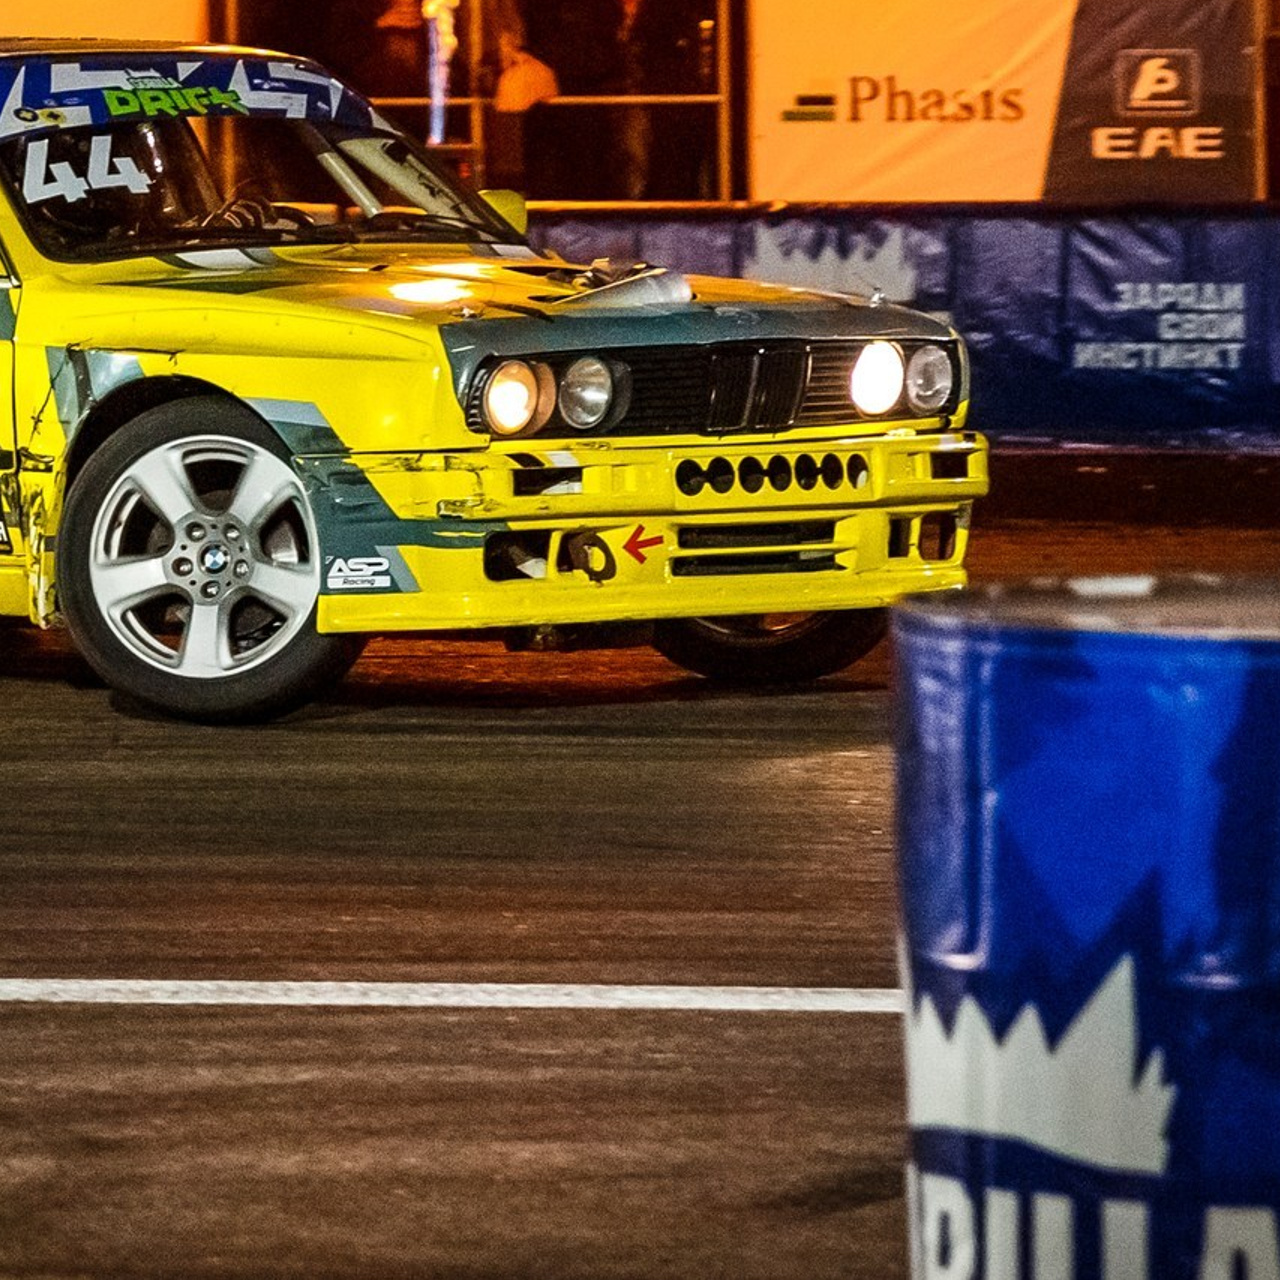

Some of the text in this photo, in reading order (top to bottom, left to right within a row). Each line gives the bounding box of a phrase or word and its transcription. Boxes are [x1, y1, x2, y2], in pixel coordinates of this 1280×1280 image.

[102, 87, 249, 116] DRIFT
[848, 77, 1025, 122] Phasis
[1091, 126, 1225, 159] EAE
[23, 136, 150, 204] 44
[328, 557, 390, 576] ASP
[342, 577, 376, 586] Racing
